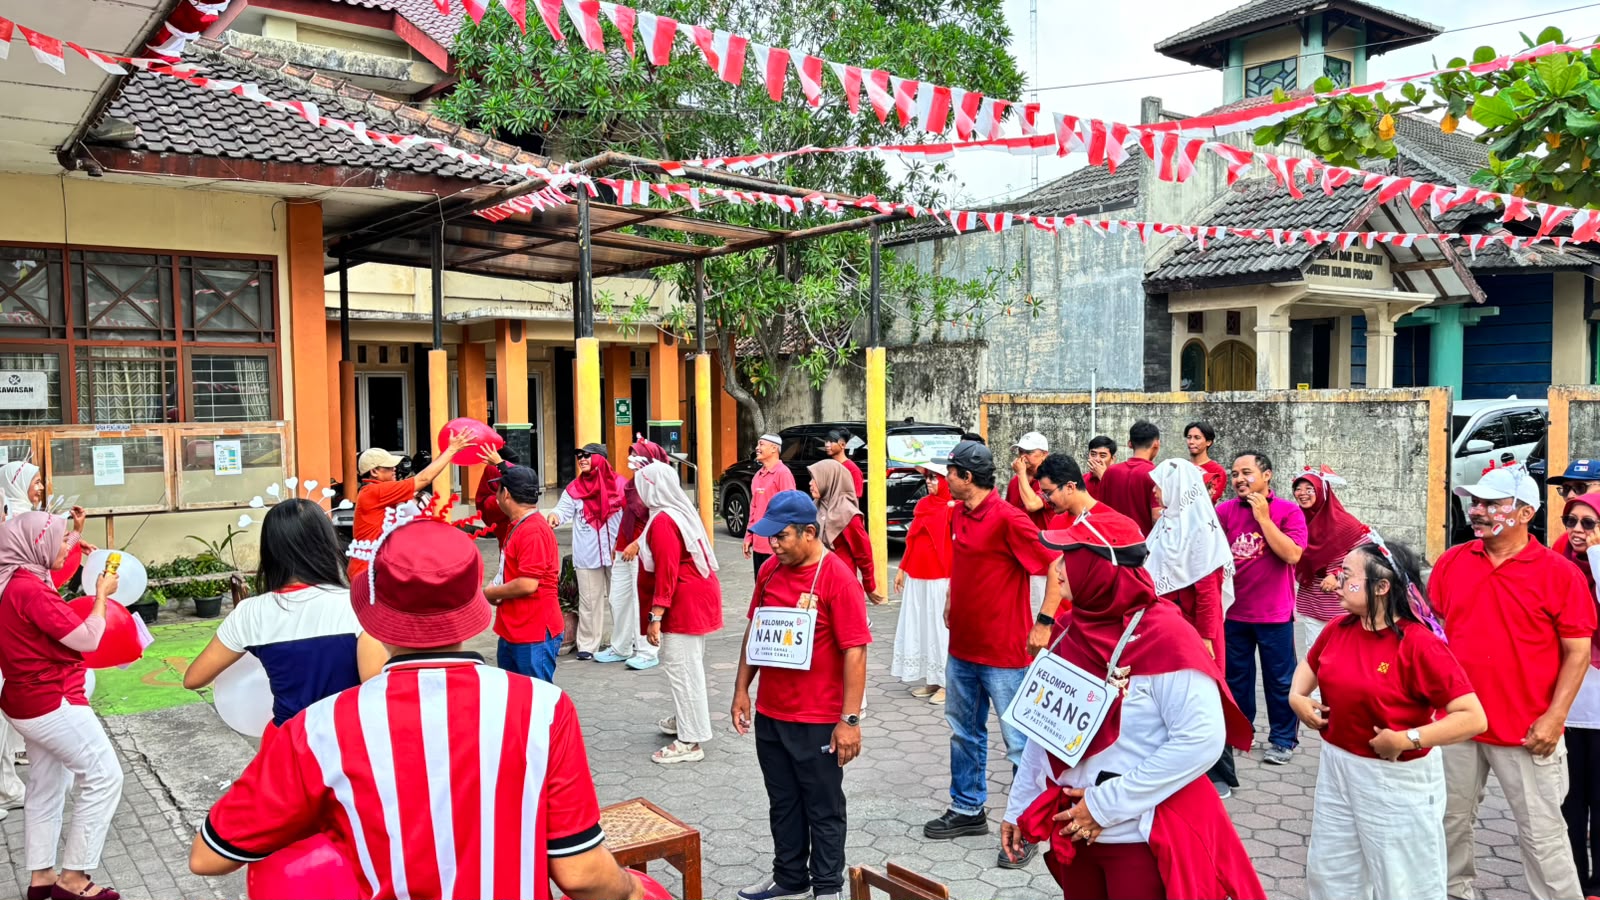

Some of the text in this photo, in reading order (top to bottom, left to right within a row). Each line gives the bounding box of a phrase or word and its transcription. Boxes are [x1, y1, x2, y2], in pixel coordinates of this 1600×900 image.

[1332, 266, 1352, 278] KULON
[1353, 268, 1373, 280] PROGO
[761, 619, 794, 627] KELOMPOK
[755, 628, 803, 646] NANAS
[1035, 667, 1078, 698] KELOMPOK
[1025, 680, 1091, 731] PISANG
[1030, 716, 1043, 727] PASTI
